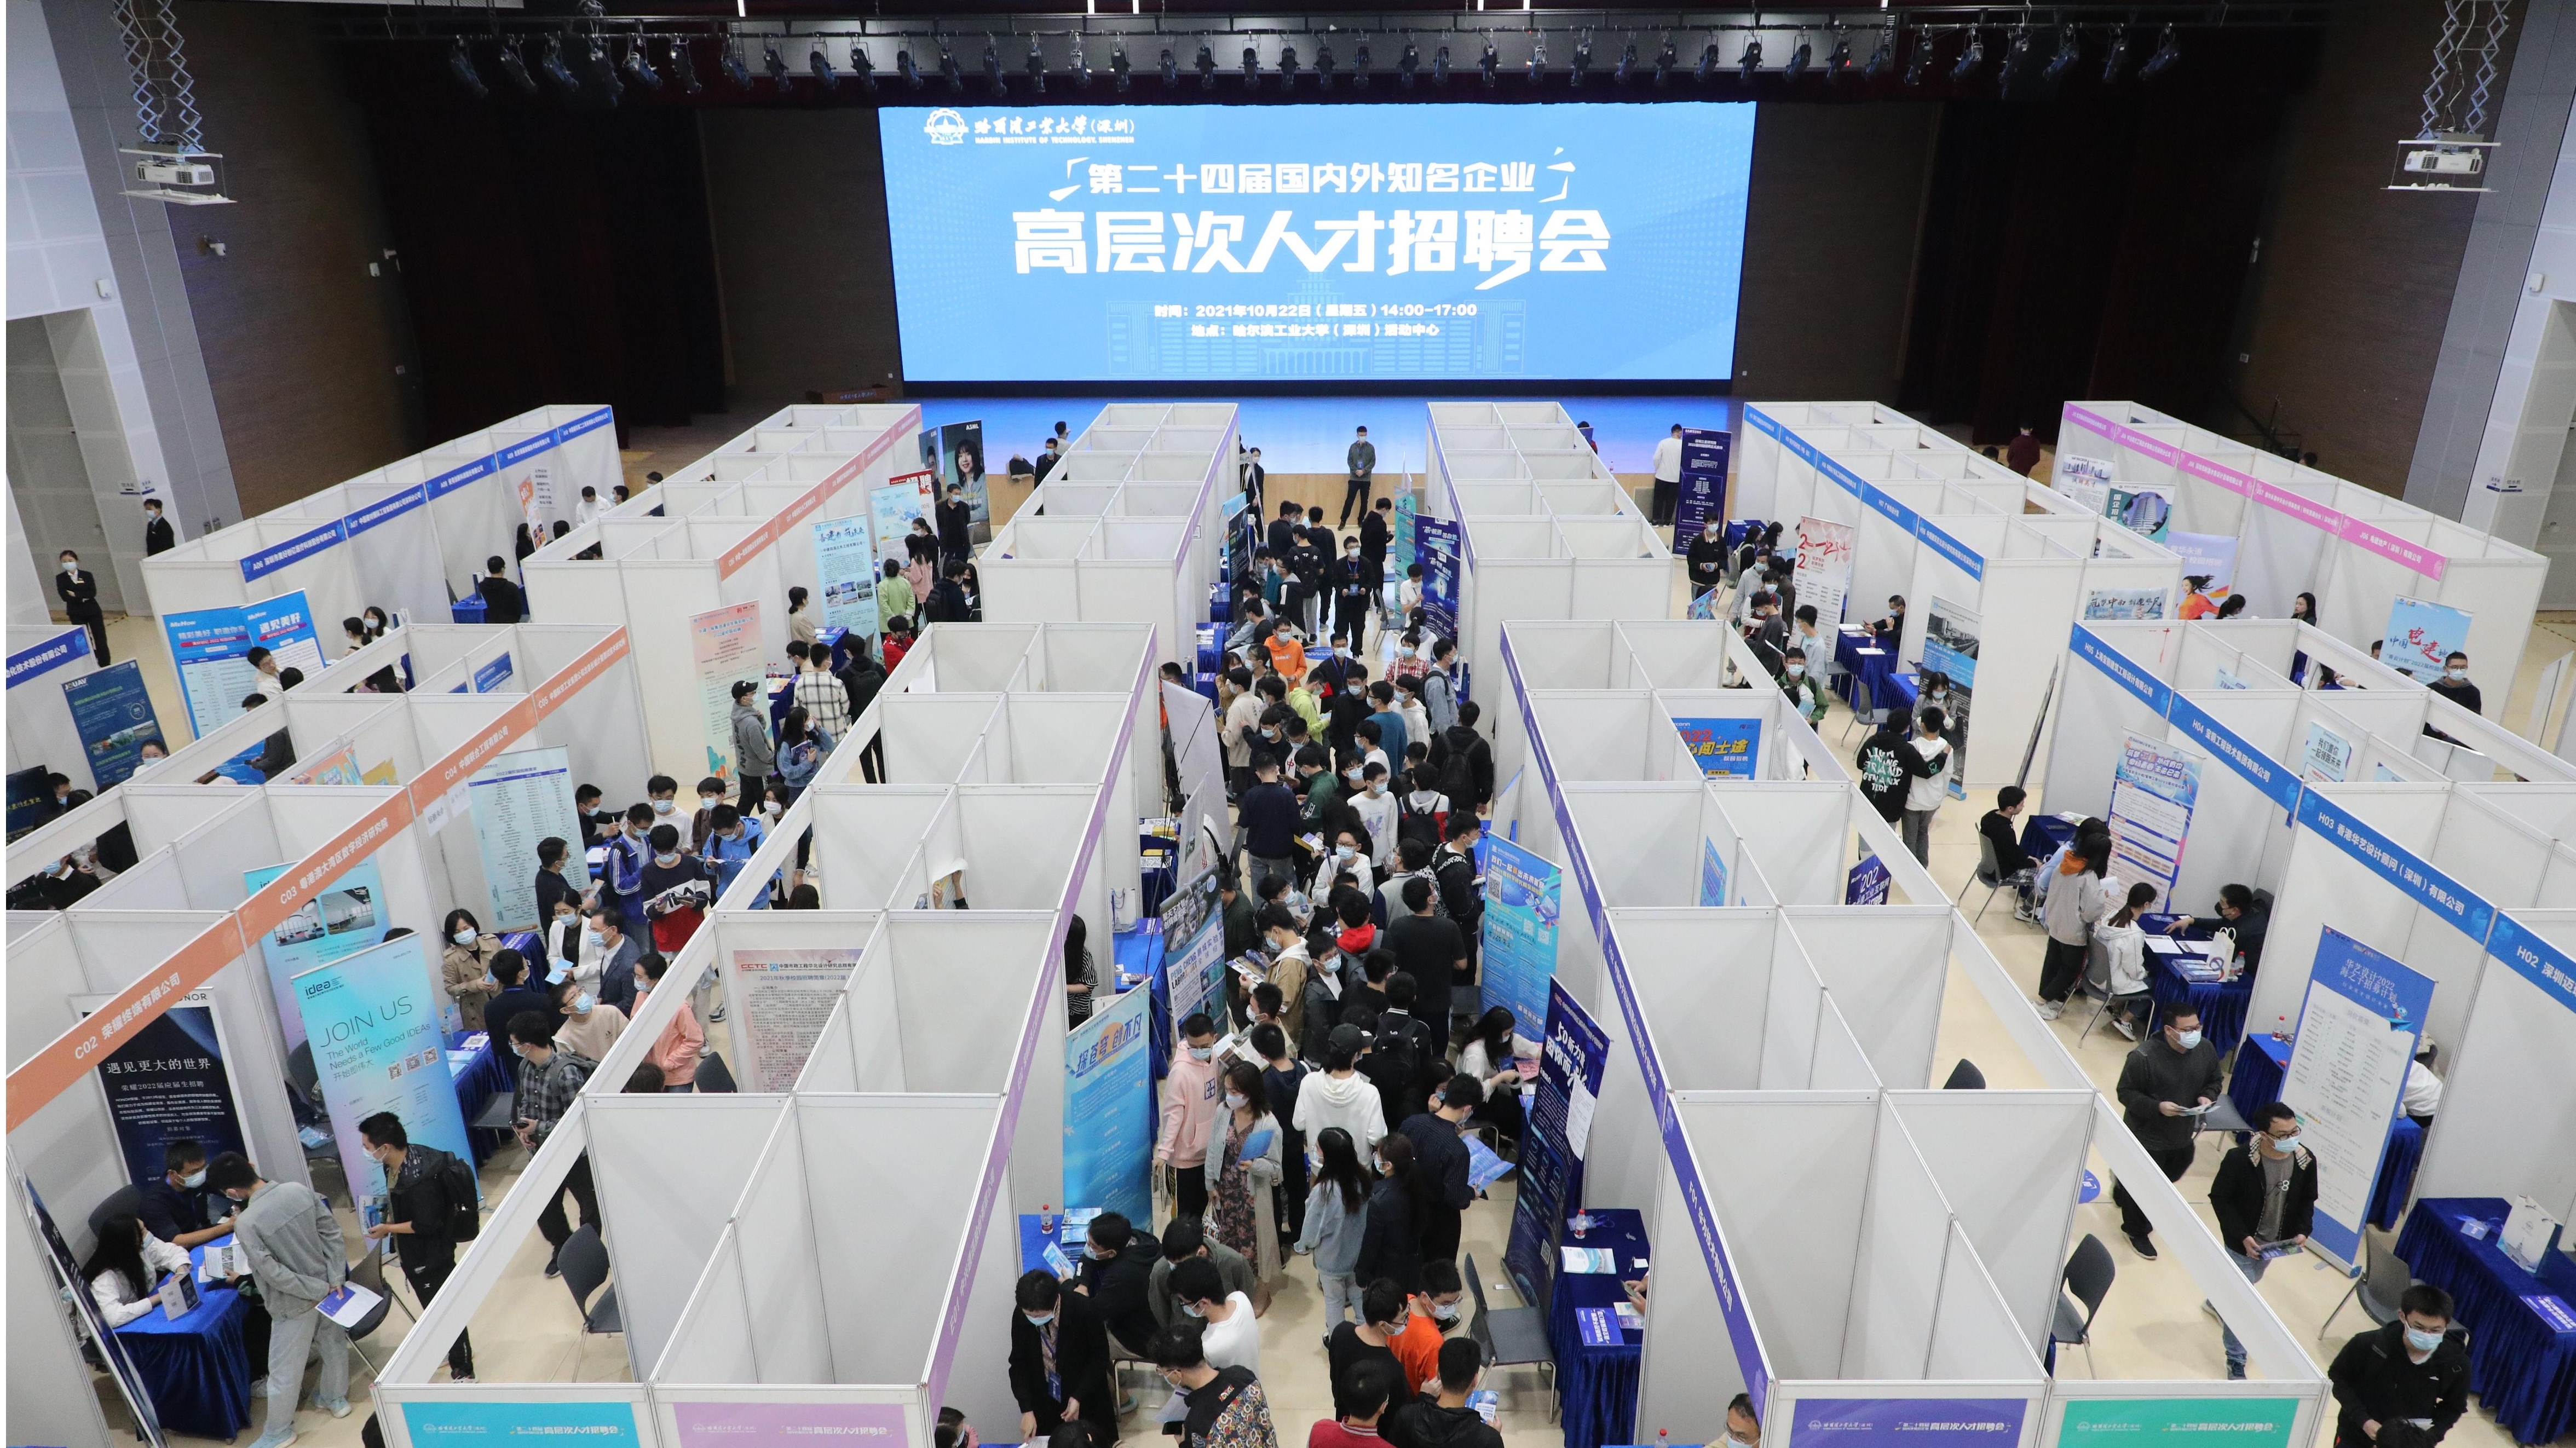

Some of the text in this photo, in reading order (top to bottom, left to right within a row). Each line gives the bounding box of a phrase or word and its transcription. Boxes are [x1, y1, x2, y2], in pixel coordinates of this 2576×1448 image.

[1088, 162, 1535, 195] 第二十四届国内外知名企业
[1012, 209, 1611, 291] 高层次人才招聘会
[2360, 529, 2368, 540] J06
[252, 560, 263, 571] A06
[259, 612, 301, 634] 遇见美好
[2084, 642, 2094, 655] H05
[2390, 627, 2457, 663] 中国电建地
[538, 695, 549, 710] C05
[1680, 729, 1713, 742] 022
[444, 724, 509, 782] C04 中国联合工程有限公司
[2192, 718, 2204, 735] H04
[2205, 726, 2270, 785] 宝钢工程技术集团有限公司
[1871, 782, 1888, 793] TIDE
[279, 814, 389, 907] C03 粤港澳大湾区数字经济研究院
[2318, 811, 2465, 918] H03 香港华艺设计顾问（深圳）有限公司
[1171, 965, 1183, 980] PENG
[1183, 952, 1197, 968] CHENG
[2517, 945, 2539, 968] H02
[304, 980, 331, 996] idea
[2340, 966, 2398, 1004] 海之子招募计划
[2346, 959, 2395, 991] 华艺设计2022
[74, 970, 181, 1064] C02 荣耀终端有限公司
[320, 995, 413, 1048] JOIN US
[327, 1037, 368, 1060] The World
[330, 1053, 357, 1070] Needs
[365, 1042, 382, 1055] Few
[384, 1031, 406, 1047] Good
[406, 1022, 431, 1039] IDEAs
[1076, 1012, 1143, 1073] 探苍穹 创不凡
[106, 1057, 211, 1075] 遇见更大的世界
[950, 1161, 995, 1341] E01 中兴通讯股份有限公司
[1688, 1178, 1733, 1316] F01 华为技术有限公司
[544, 1426, 619, 1435] 高层次人才招聘会
[814, 1426, 888, 1436] 高层次人才招聘会
[1930, 1422, 2004, 1433] 高层次人才招聘会
[2198, 1423, 2273, 1433] 高层次人才招聘会
